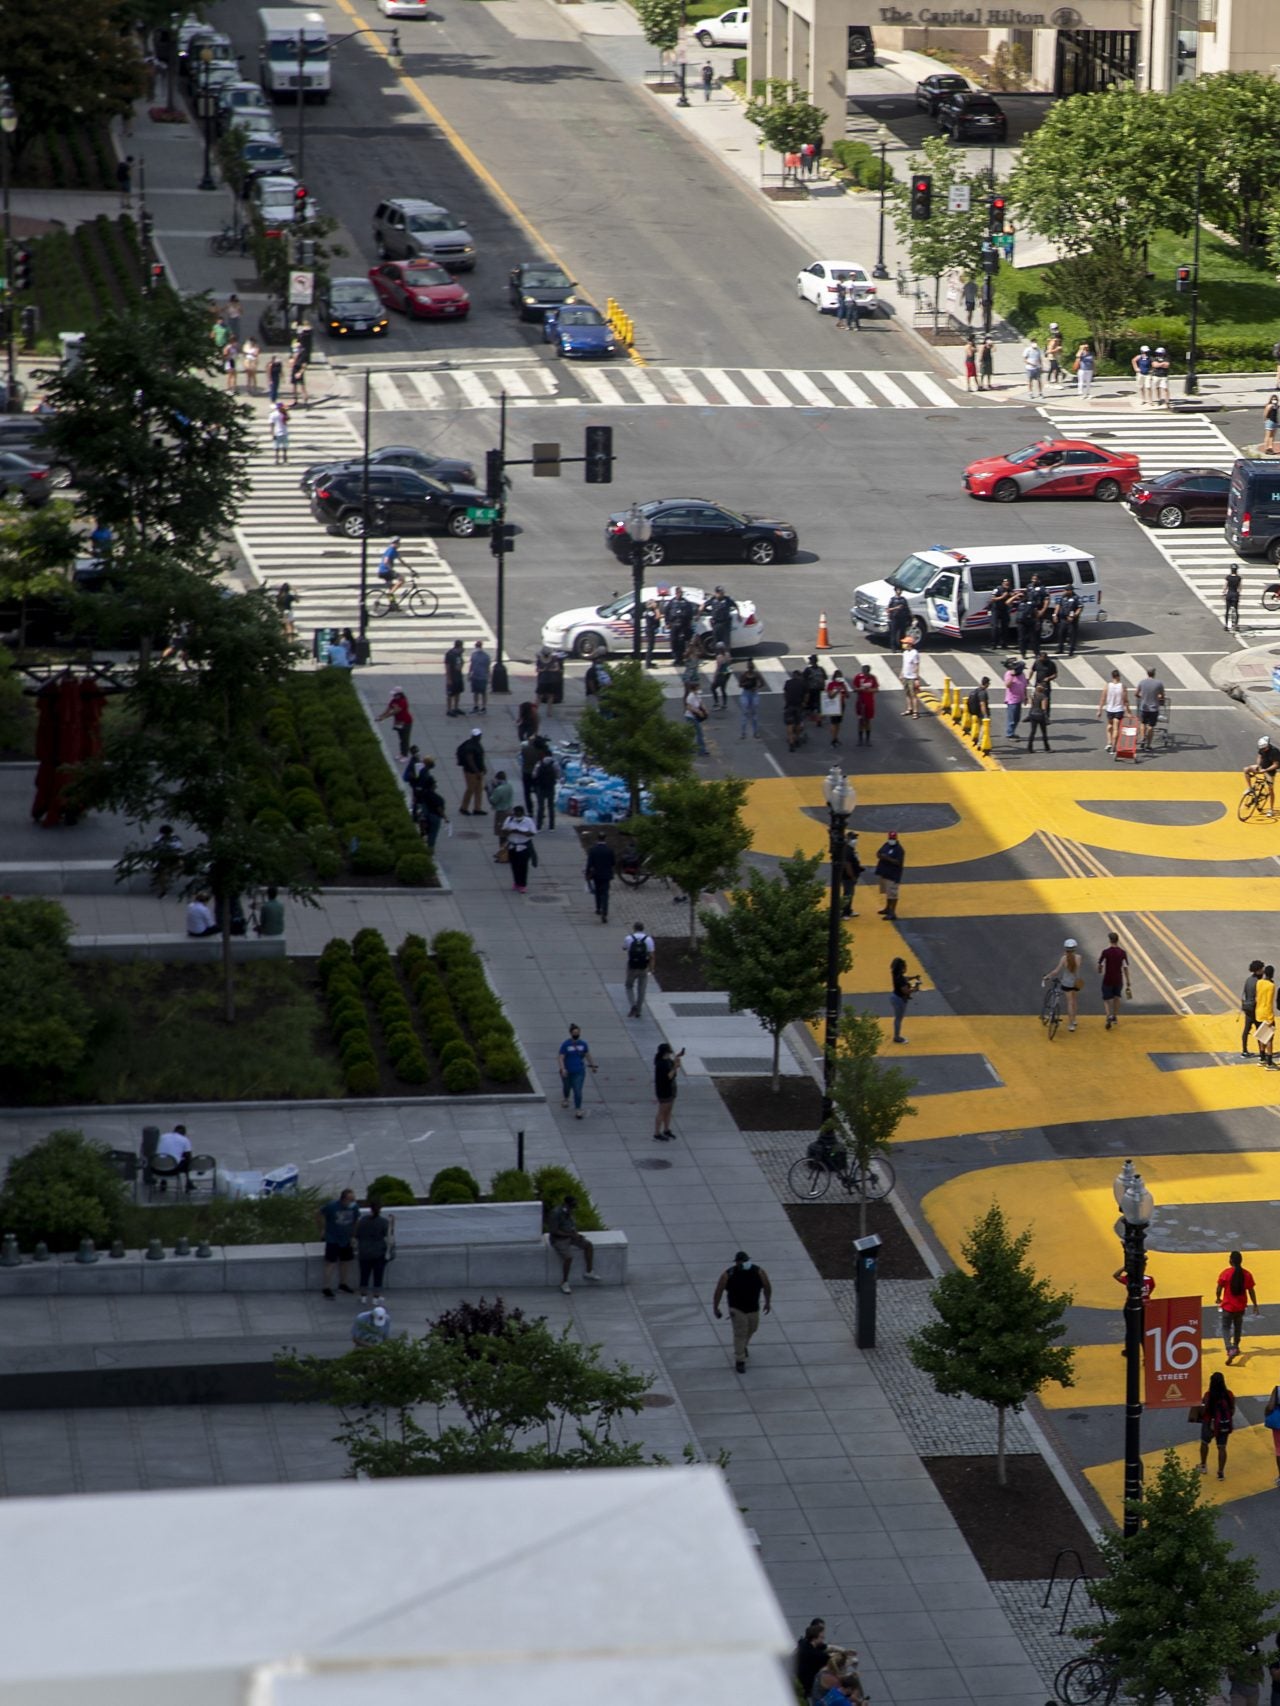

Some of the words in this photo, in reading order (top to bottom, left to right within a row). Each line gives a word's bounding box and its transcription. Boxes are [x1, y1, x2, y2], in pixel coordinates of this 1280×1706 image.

[879, 7, 913, 22] The
[918, 8, 982, 25] Capital
[987, 10, 1045, 24] Hilton
[865, 1258, 874, 1269] P
[1145, 1325, 1199, 1372] 16
[1157, 1372, 1189, 1381] STREET
